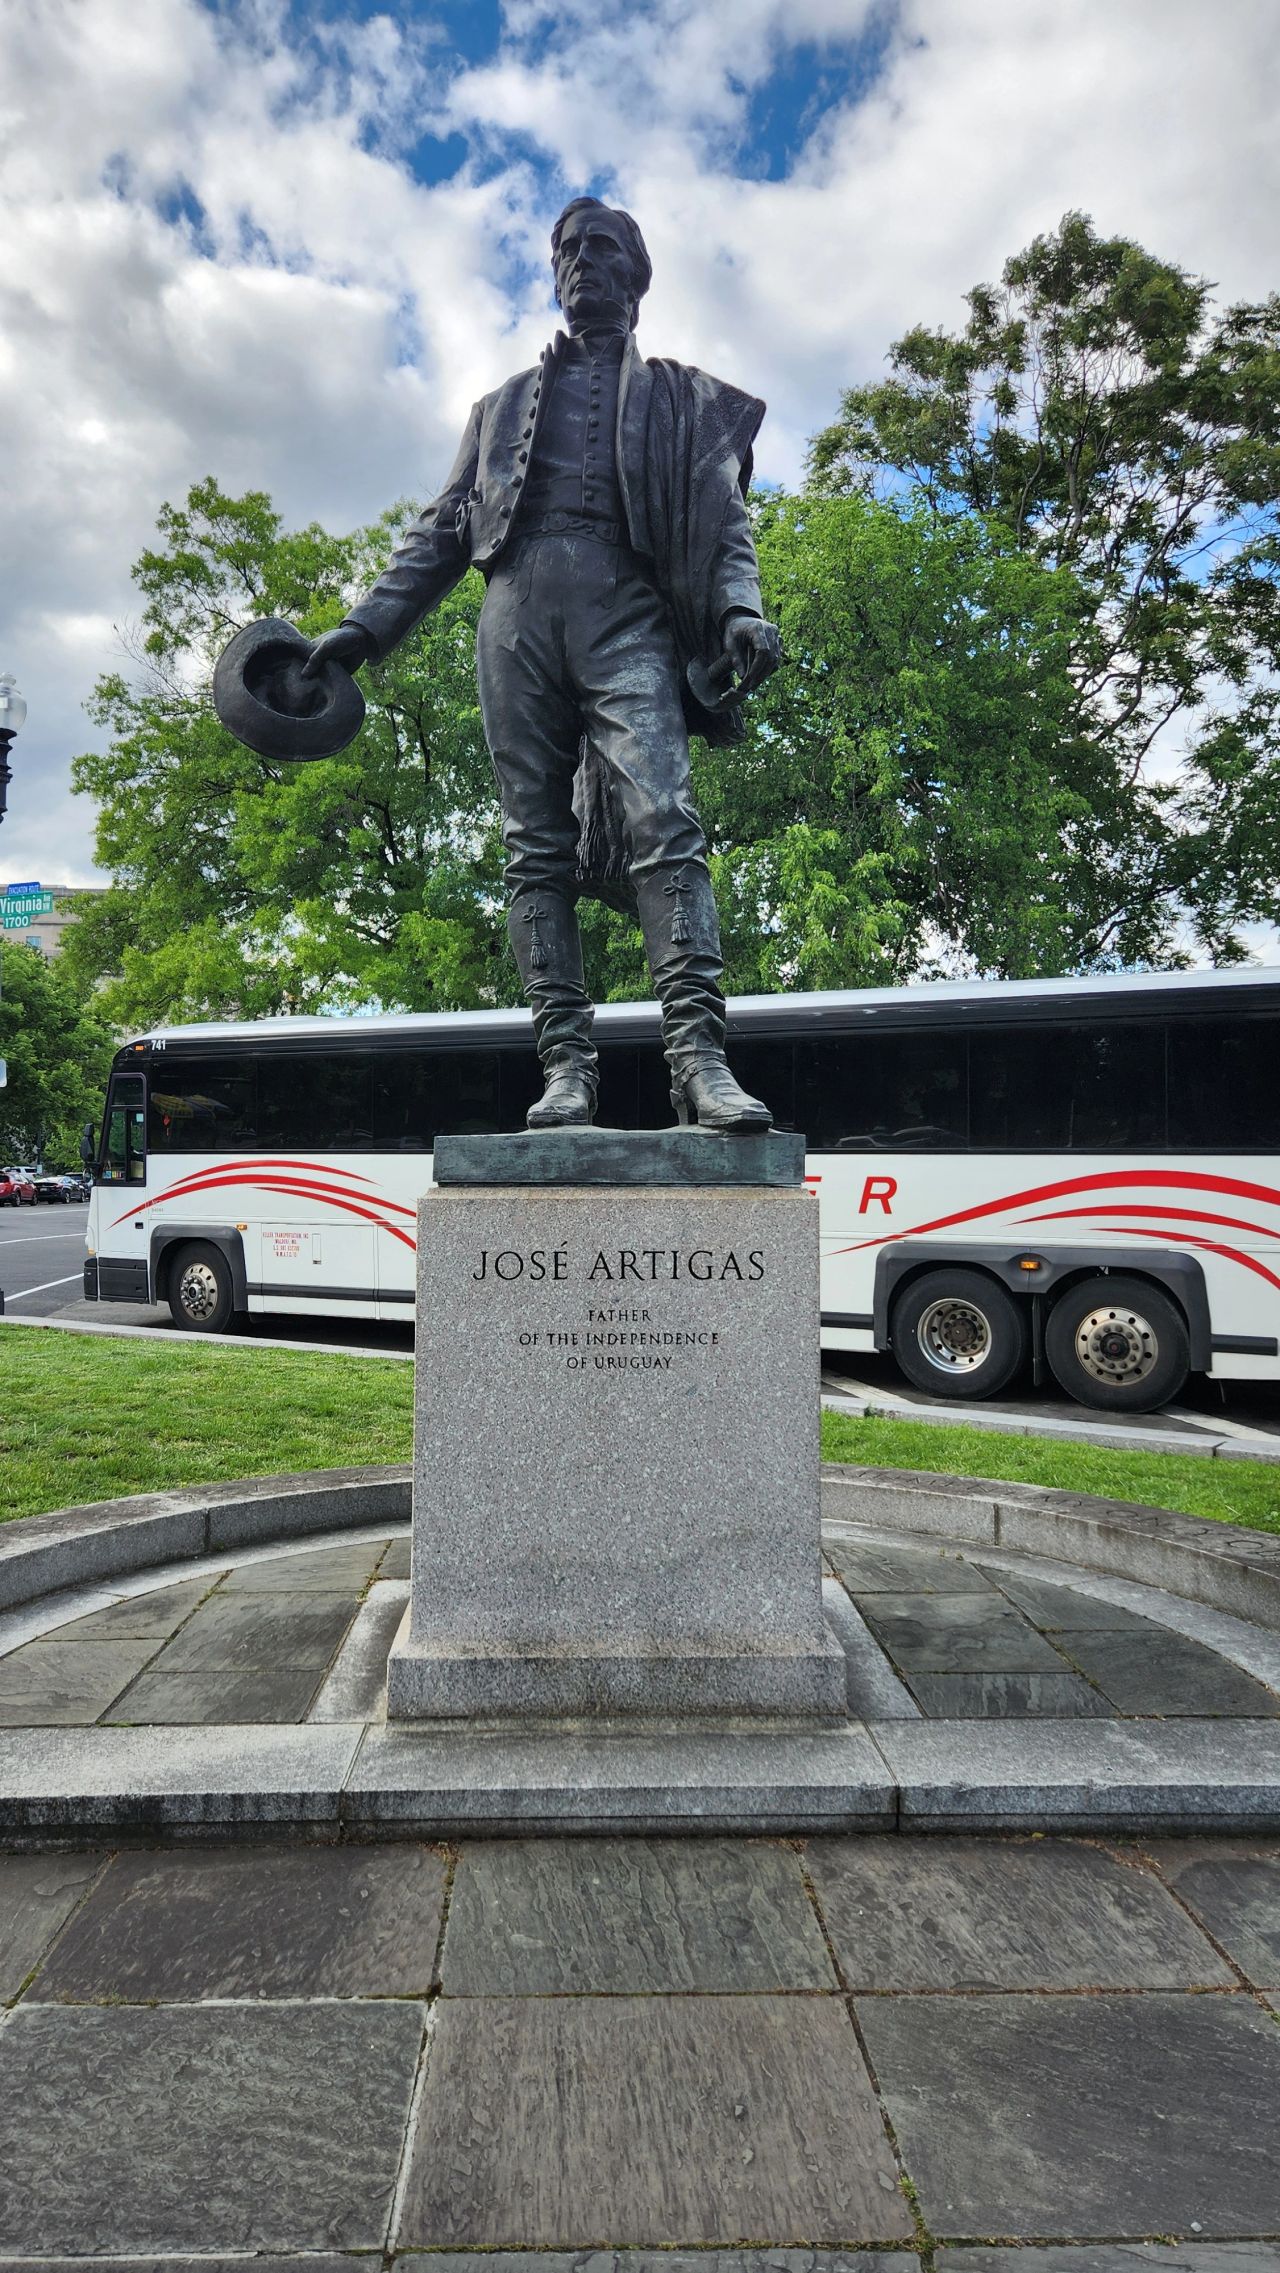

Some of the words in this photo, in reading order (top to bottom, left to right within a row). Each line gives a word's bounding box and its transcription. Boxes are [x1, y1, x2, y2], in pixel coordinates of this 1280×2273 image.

[0, 894, 42, 914] Virginia
[5, 916, 29, 928] 1700
[151, 1040, 166, 1050] 741
[472, 1240, 569, 1281] JOSÉ
[587, 1250, 766, 1281] ARTIGAS
[588, 1309, 652, 1322] FATHER
[519, 1333, 540, 1345] OF
[546, 1333, 579, 1345] THE
[585, 1333, 720, 1345] INDEPENDENCE
[566, 1357, 588, 1369] OF
[594, 1357, 673, 1369] URUGUAY
